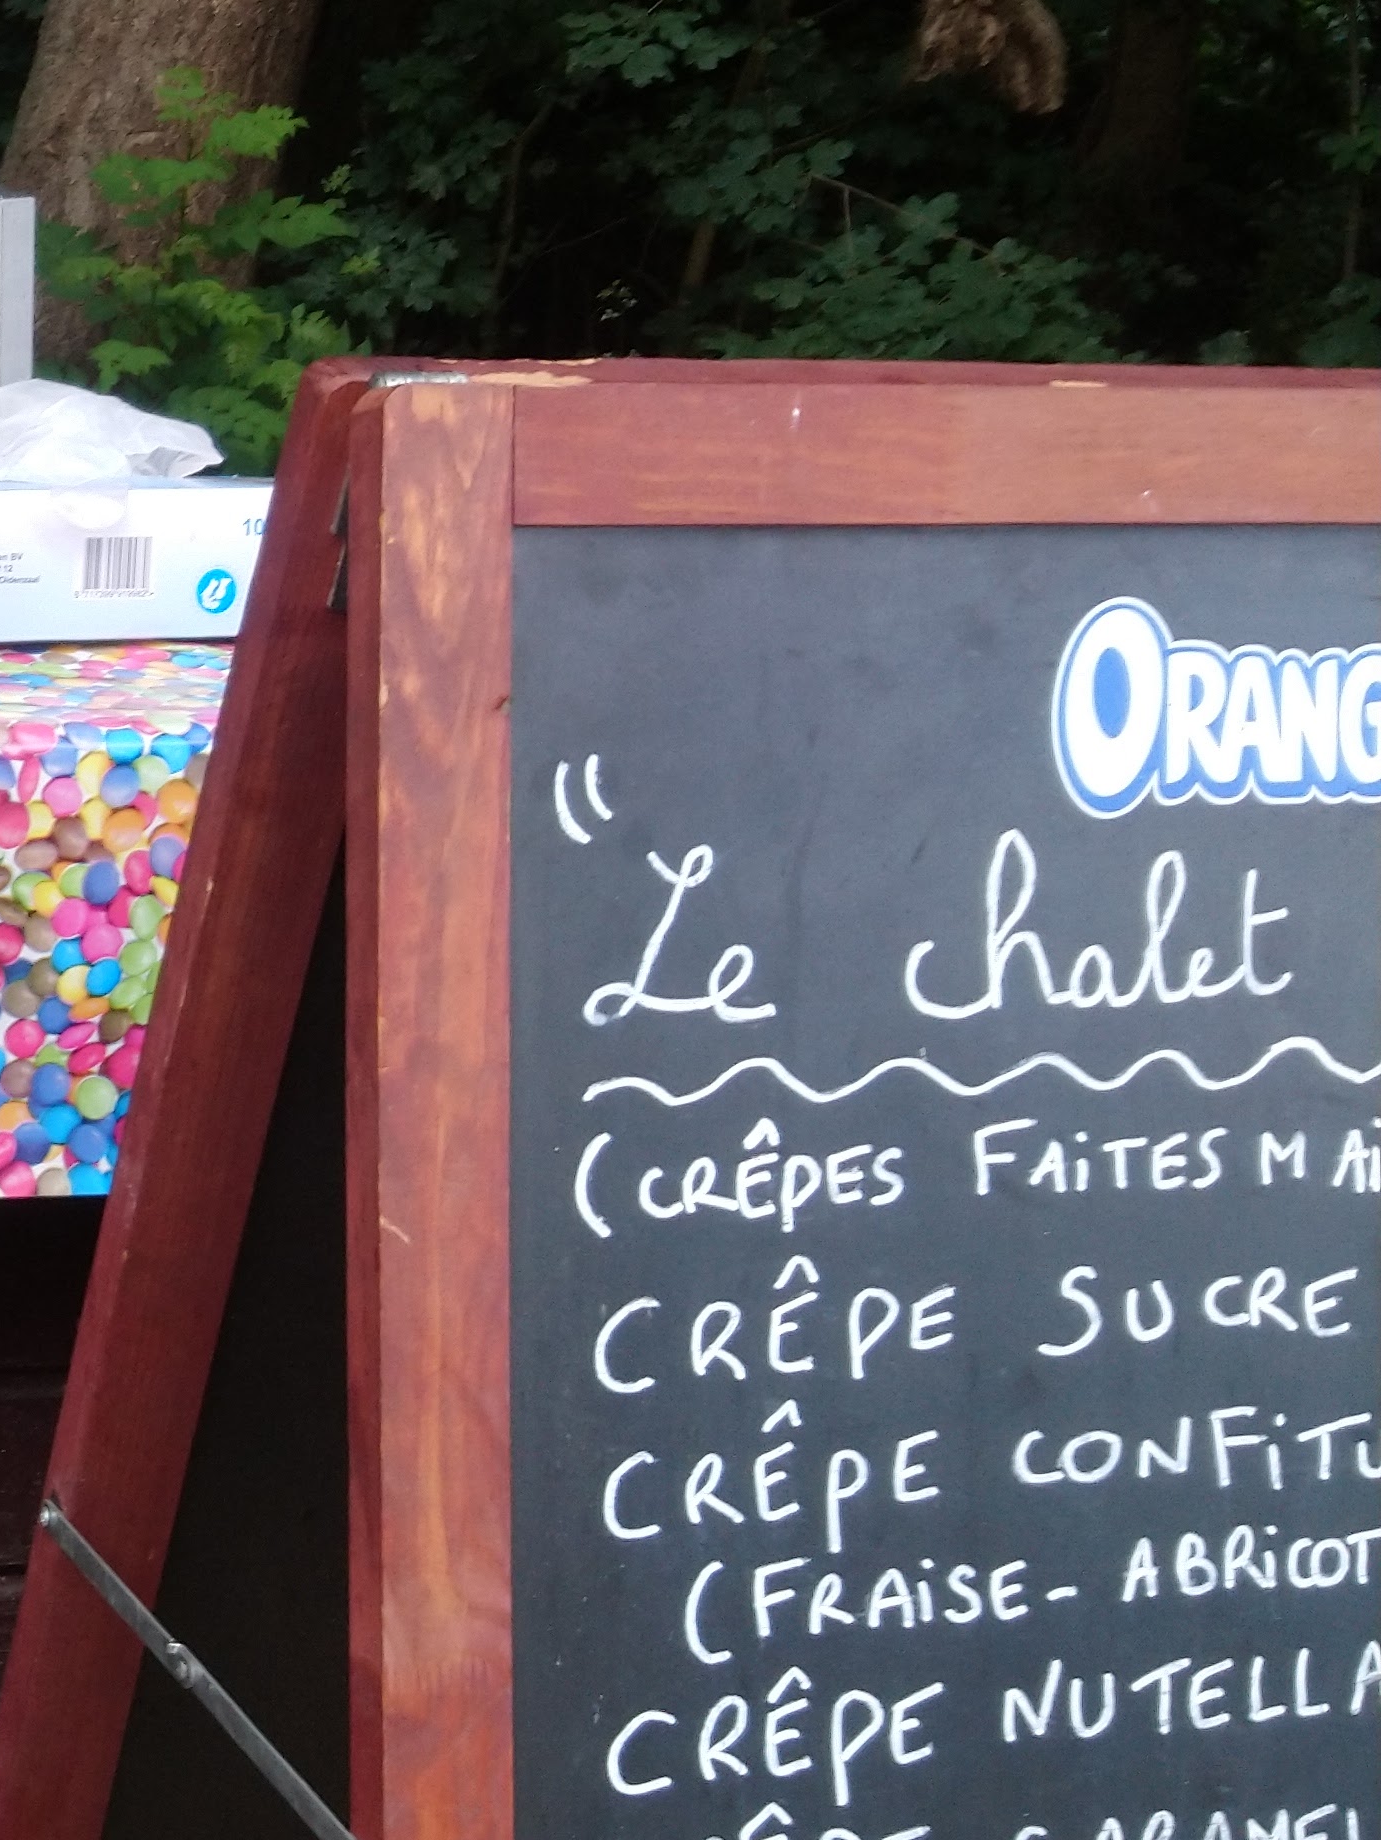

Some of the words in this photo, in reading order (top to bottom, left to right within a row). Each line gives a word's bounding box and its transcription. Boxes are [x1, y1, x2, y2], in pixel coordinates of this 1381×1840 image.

[594, 1255, 957, 1393] CRÊPE
[1038, 1265, 1359, 1356] SUCRE
[602, 1399, 941, 1554] CRÊPE
[607, 1667, 944, 1806] CRÊPE
[1003, 1640, 1381, 1743] NUTELLA
